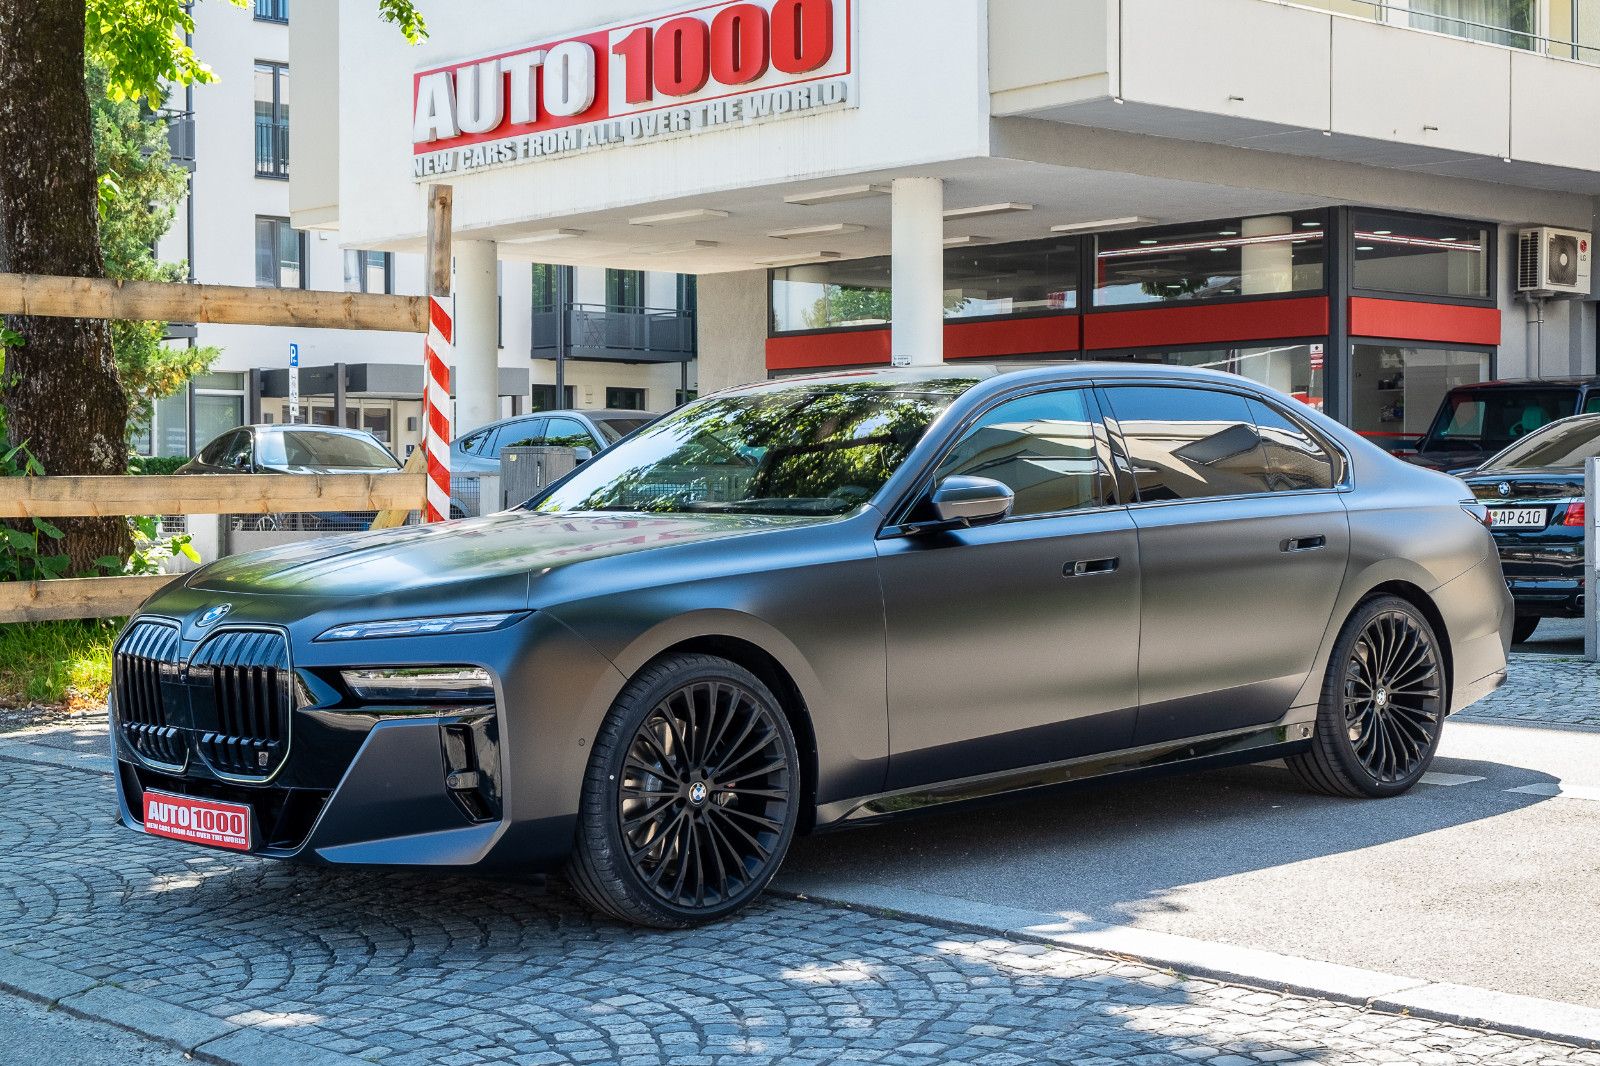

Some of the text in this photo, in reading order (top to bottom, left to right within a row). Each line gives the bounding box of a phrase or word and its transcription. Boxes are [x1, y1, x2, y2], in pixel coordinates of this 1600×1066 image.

[413, 0, 834, 143] AUTO 1000
[413, 81, 848, 178] NEW CARS FROM ALL OVER THE WORLD
[1499, 511, 1541, 524] AP 610
[148, 800, 243, 835] AUTO 1000
[196, 832, 211, 840] OVER
[212, 834, 223, 842] THE
[223, 835, 246, 845] WORLD
